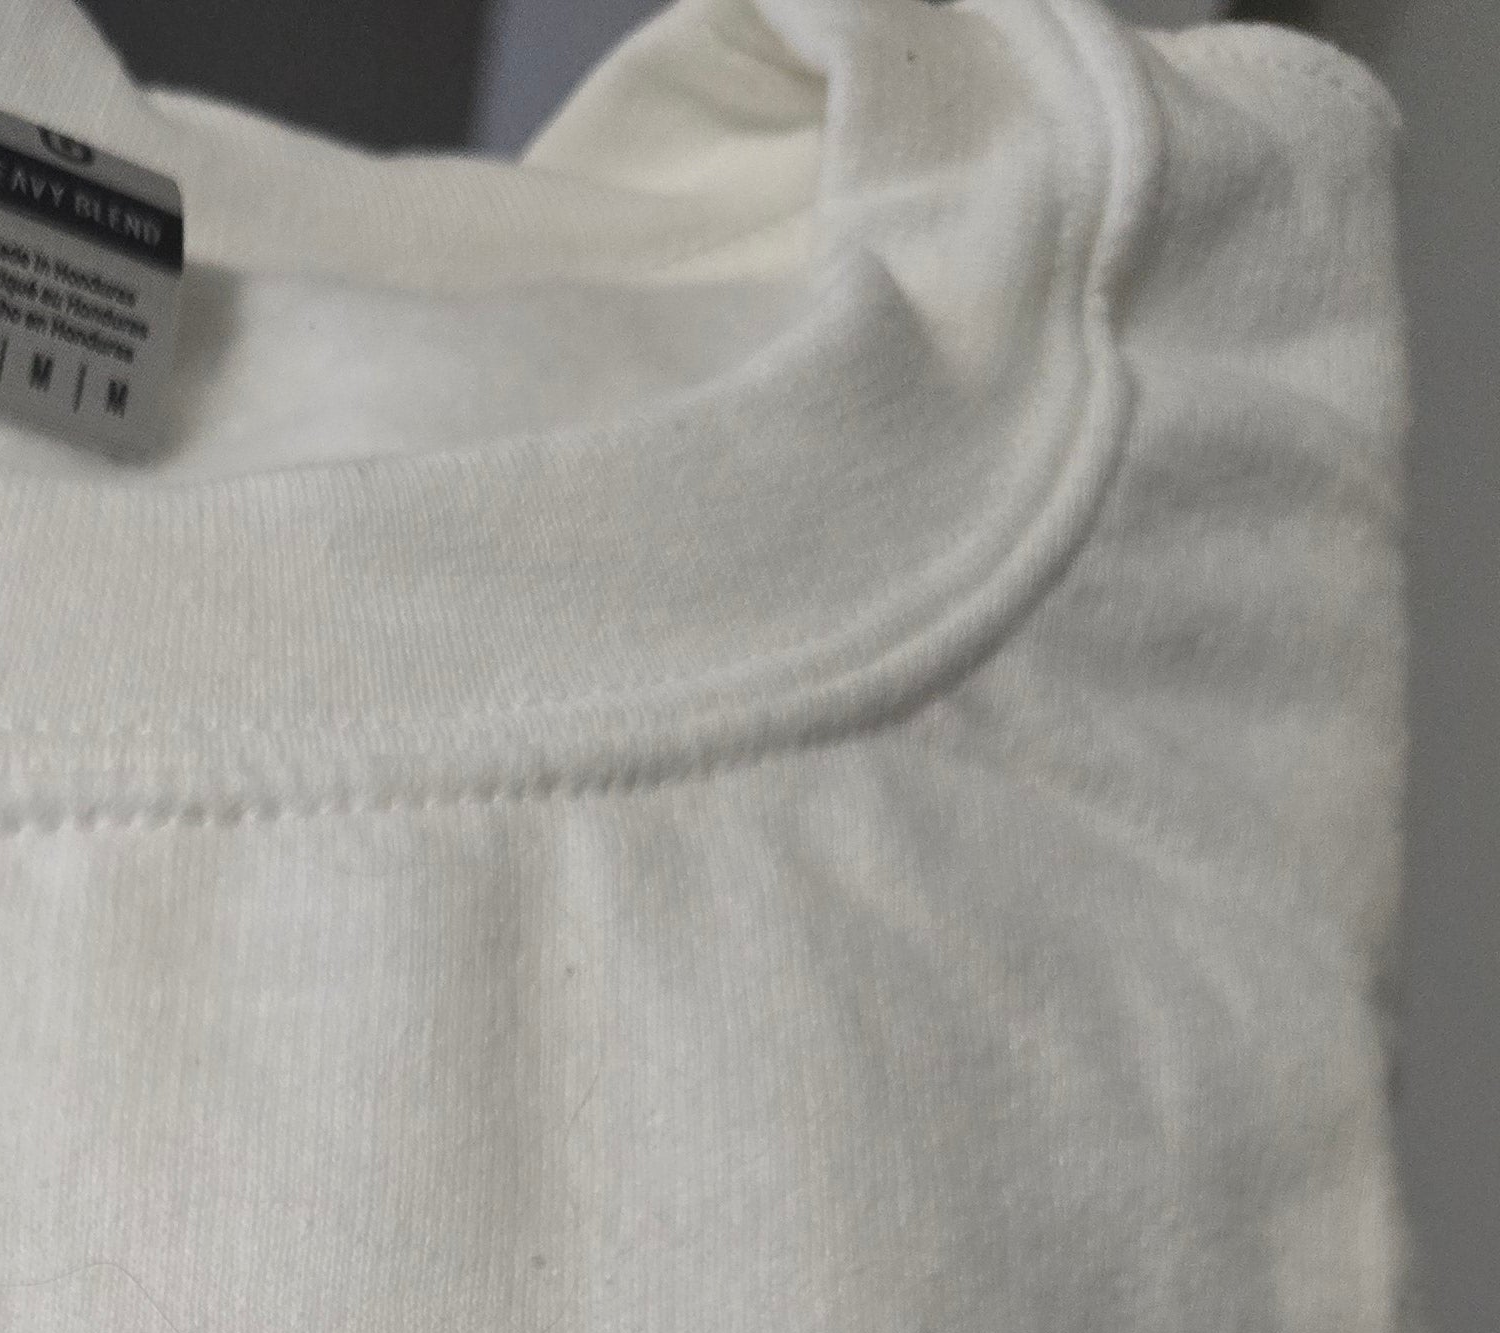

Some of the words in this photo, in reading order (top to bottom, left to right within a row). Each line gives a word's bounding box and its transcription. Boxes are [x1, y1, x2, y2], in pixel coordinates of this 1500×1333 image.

[75, 193, 161, 246] BLEND
[33, 250, 50, 274] in
[52, 257, 137, 308] Honduras
[24, 311, 48, 334] en
[49, 316, 135, 364] Honduras
[64, 291, 150, 341] Honduras
[29, 351, 54, 392] M
[105, 378, 130, 418] M
